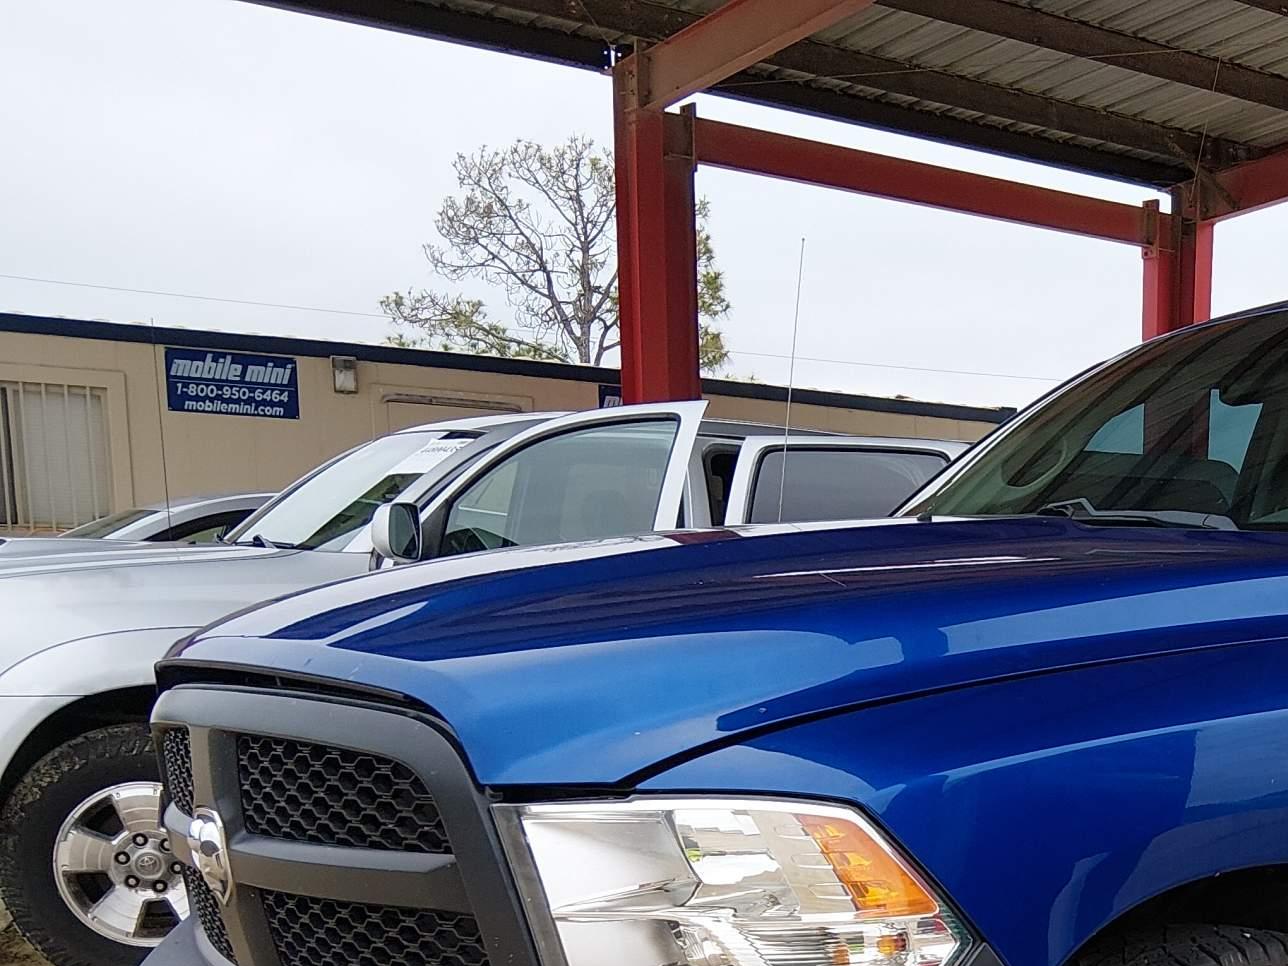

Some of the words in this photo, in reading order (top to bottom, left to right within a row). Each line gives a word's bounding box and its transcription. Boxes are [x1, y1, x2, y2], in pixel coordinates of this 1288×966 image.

[170, 353, 242, 380] mobile
[245, 362, 292, 384] mini
[176, 383, 289, 402] 1-800-950-6464
[184, 400, 284, 416] mobilemini.com
